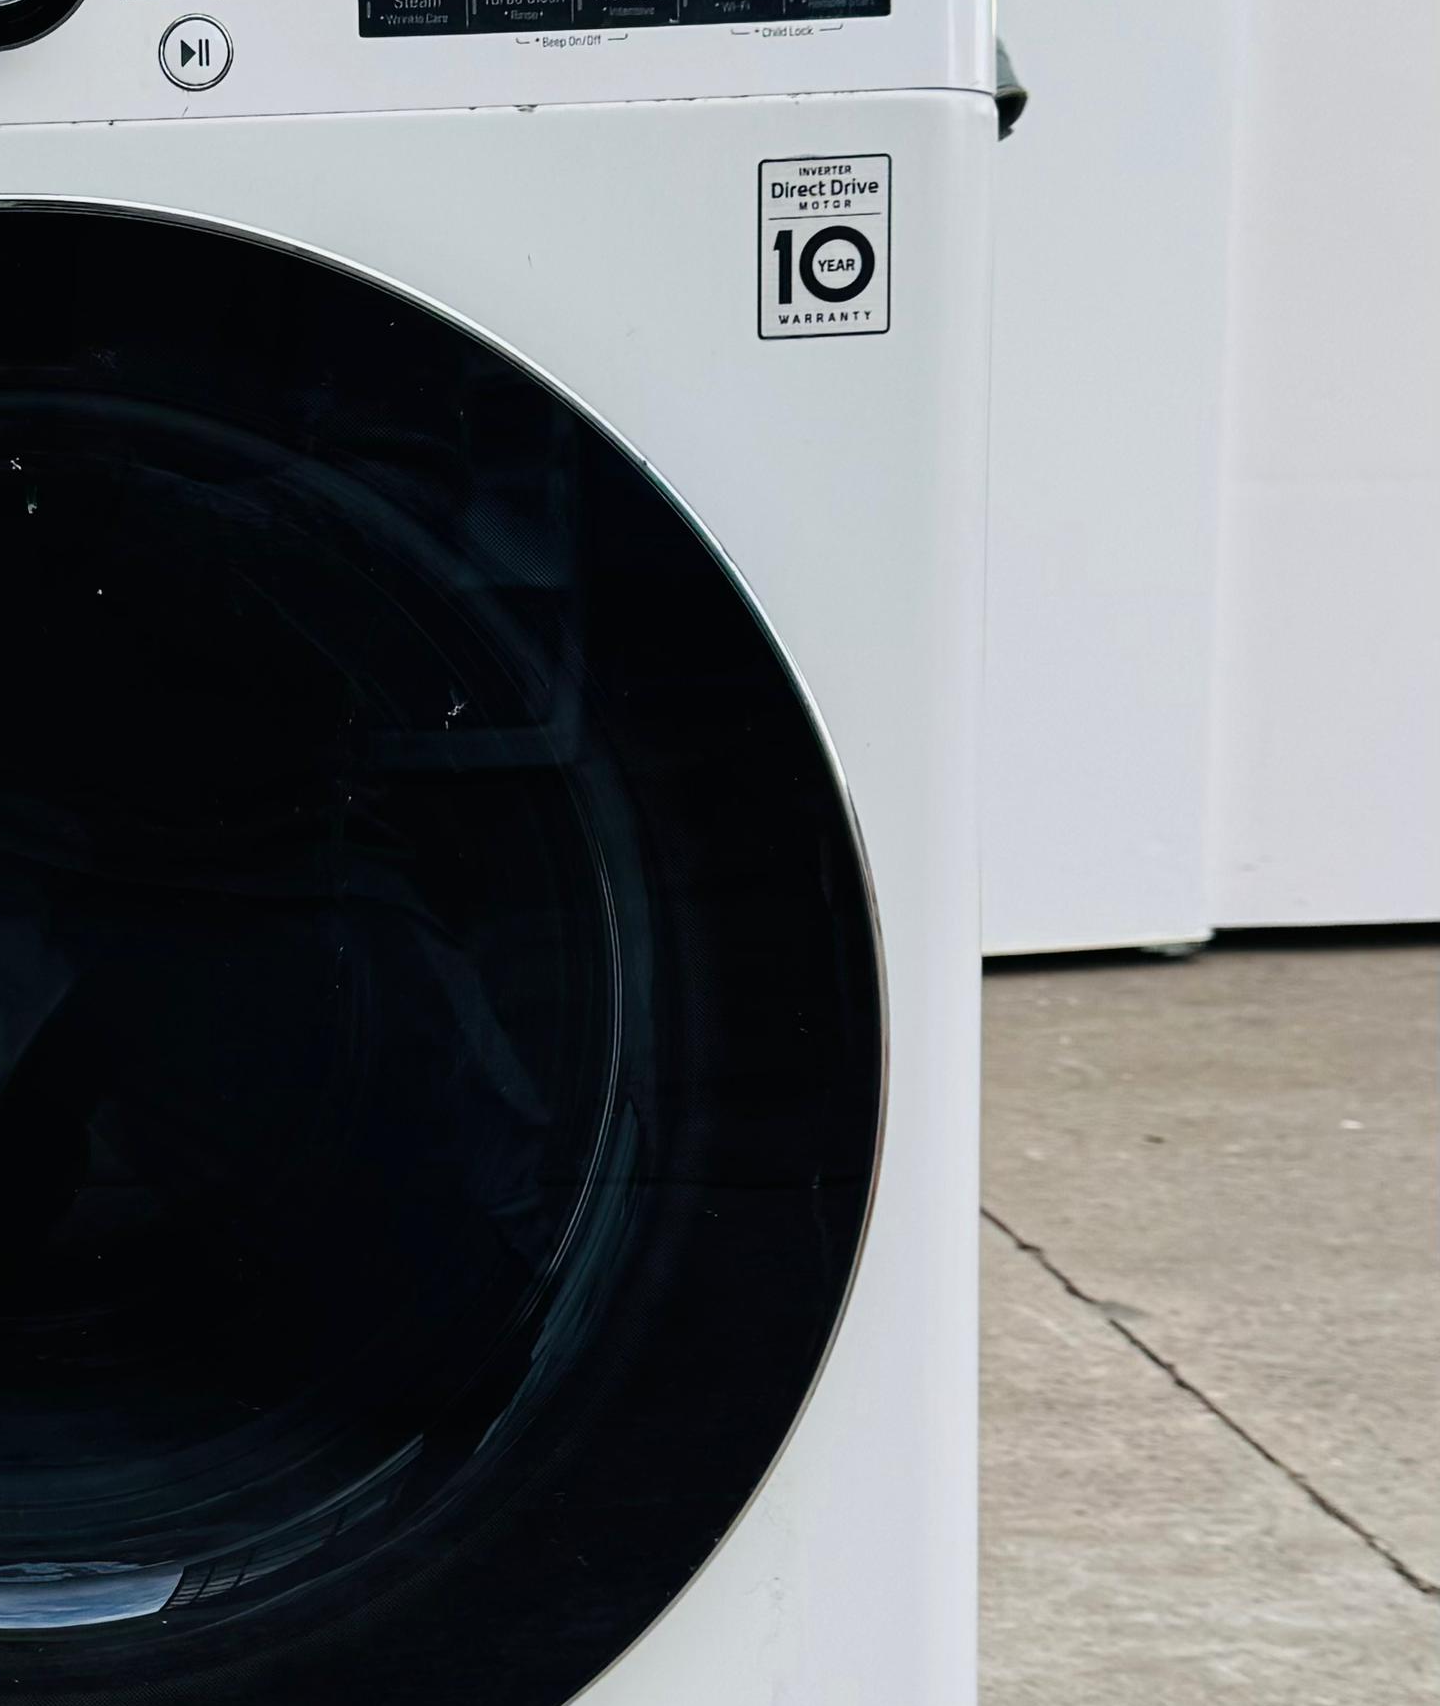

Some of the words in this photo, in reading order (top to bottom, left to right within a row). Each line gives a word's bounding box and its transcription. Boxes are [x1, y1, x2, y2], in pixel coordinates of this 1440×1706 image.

[762, 27, 787, 38] Child
[789, 26, 813, 37] Lock
[542, 36, 566, 49] Beep
[568, 34, 601, 47] On/Off
[799, 165, 852, 177] INVERTER
[771, 180, 826, 199] Direct
[830, 178, 879, 196] Drive
[799, 199, 852, 211] MOTOR
[773, 225, 875, 305] 10
[818, 258, 855, 273] YEAR
[778, 311, 872, 325] WARRANTY
